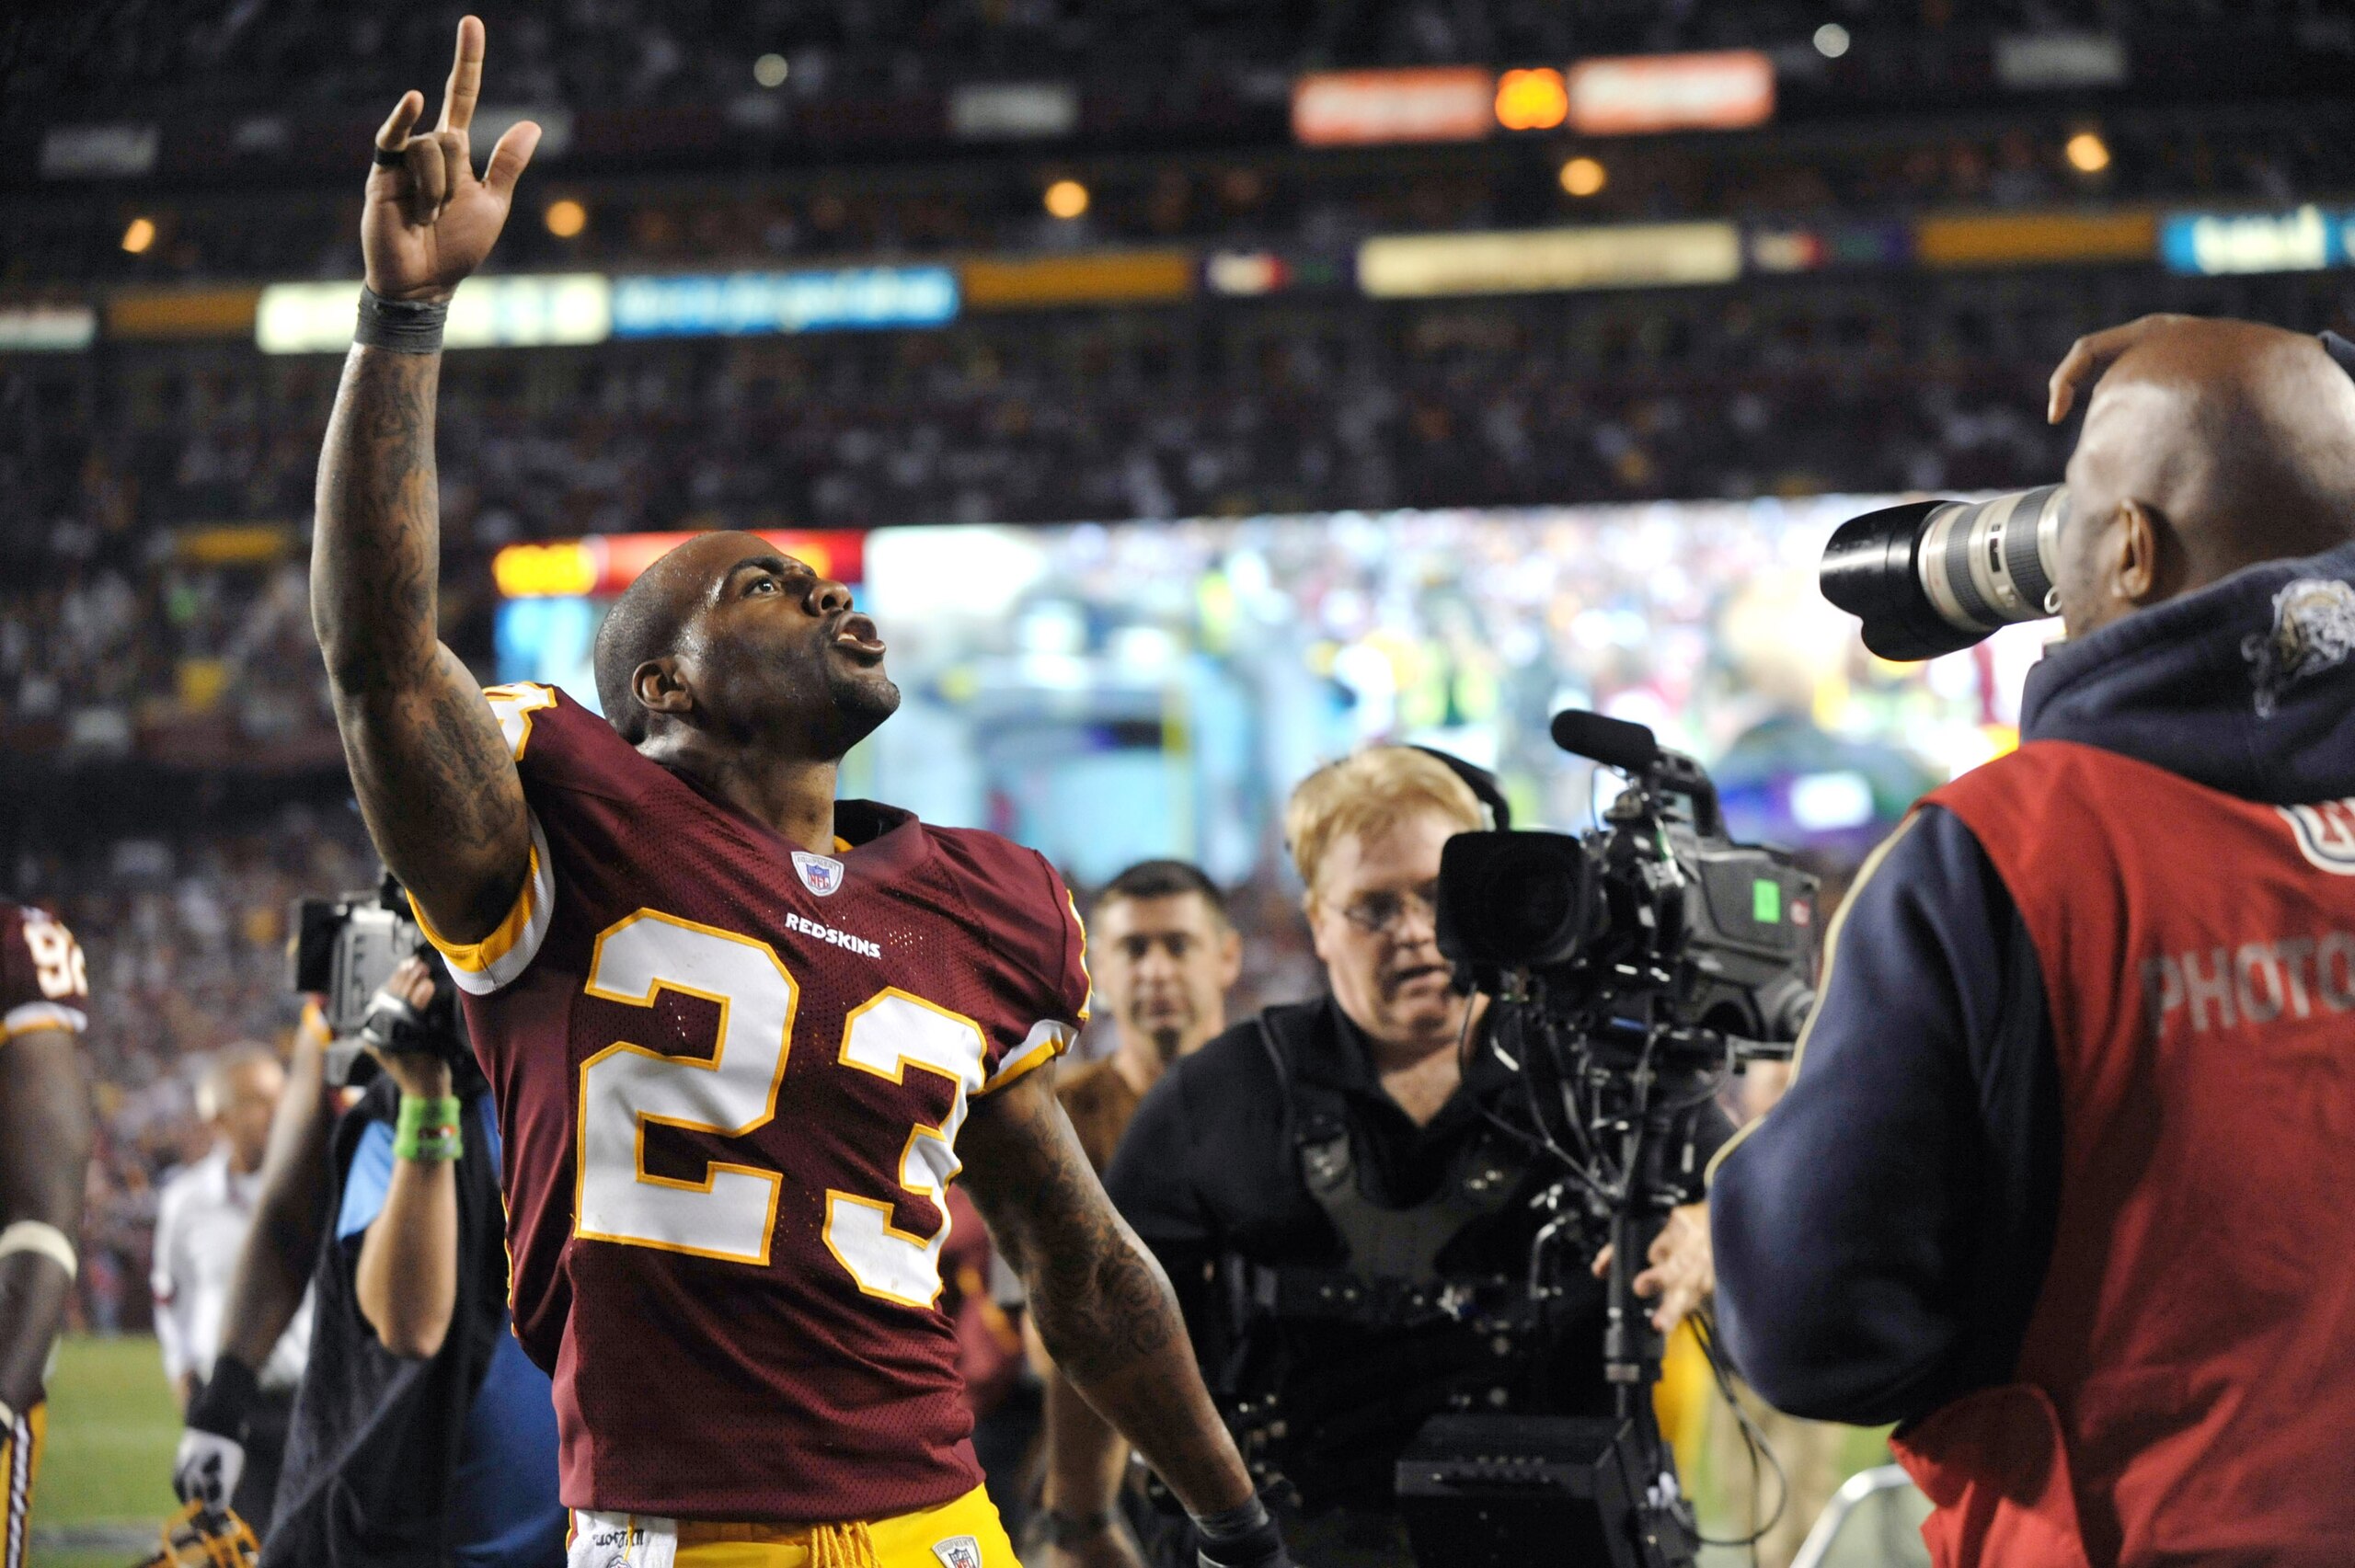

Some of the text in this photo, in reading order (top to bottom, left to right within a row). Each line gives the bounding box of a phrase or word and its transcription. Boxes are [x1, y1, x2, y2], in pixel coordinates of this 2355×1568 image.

[809, 874, 830, 889] NFL
[785, 912, 881, 958] REDSKINS
[573, 908, 988, 1310] 23
